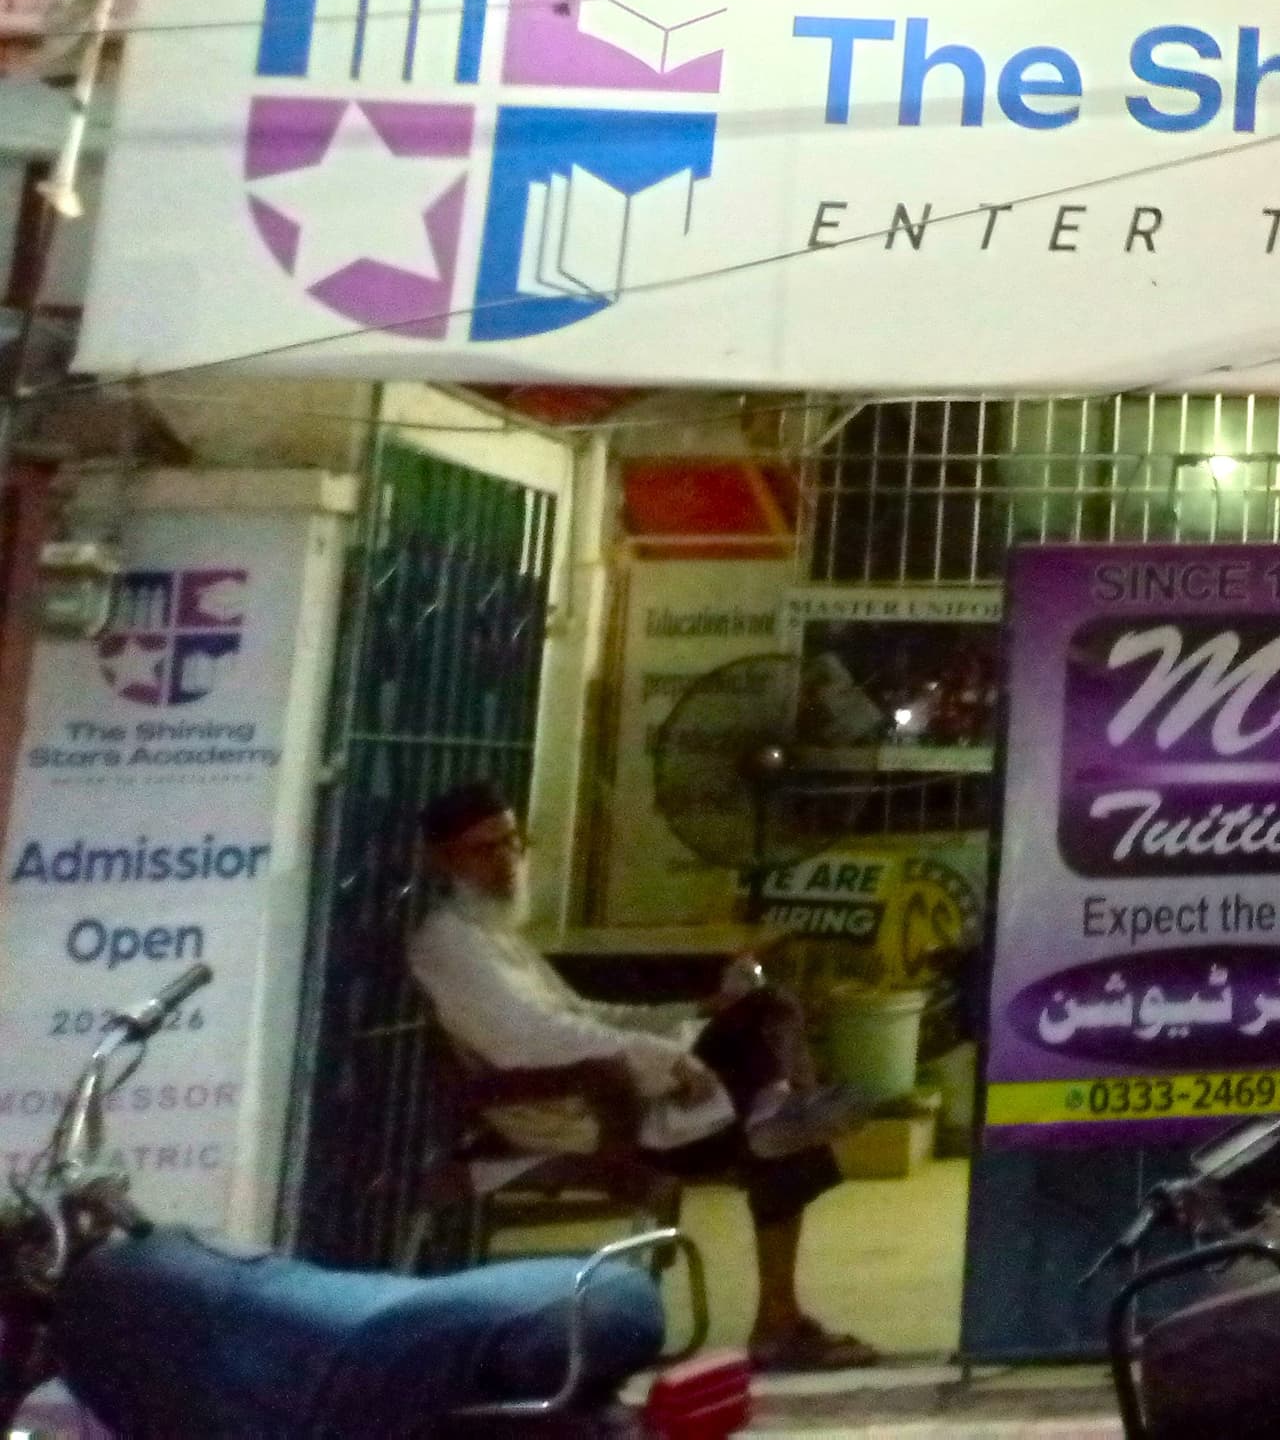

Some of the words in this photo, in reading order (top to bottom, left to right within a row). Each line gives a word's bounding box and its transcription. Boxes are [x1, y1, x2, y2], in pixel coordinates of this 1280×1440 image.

[792, 13, 1083, 134] The
[806, 199, 1168, 257] ENTER
[1093, 564, 1251, 602] SINCE
[63, 720, 127, 742] The
[135, 718, 256, 743] Shining
[26, 747, 123, 770] Stars
[65, 918, 204, 972] Open
[1082, 894, 1209, 949] Expect
[1219, 893, 1278, 931] the
